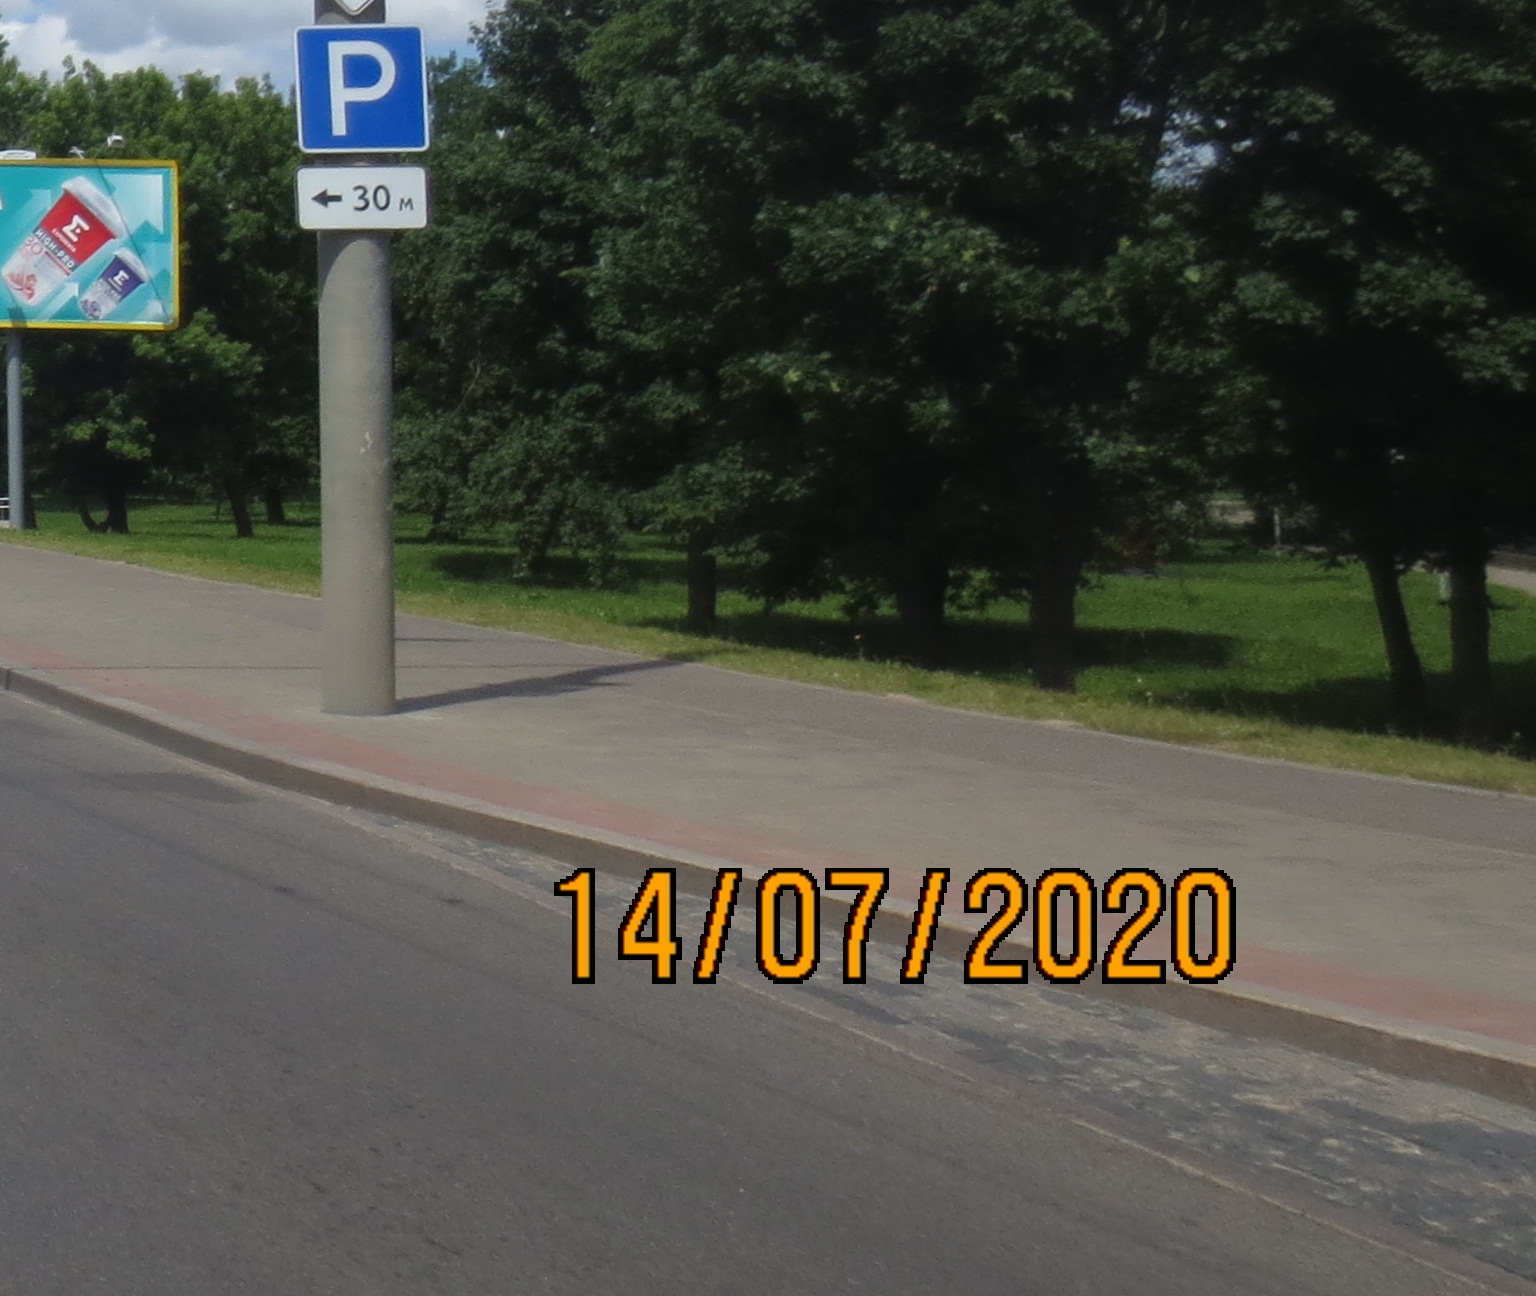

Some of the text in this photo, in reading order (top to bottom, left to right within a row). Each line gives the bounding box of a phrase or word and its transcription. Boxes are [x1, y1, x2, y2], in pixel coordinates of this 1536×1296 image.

[328, 40, 397, 136] P
[352, 184, 391, 212] 30
[34, 227, 75, 269] HIGH-PRO
